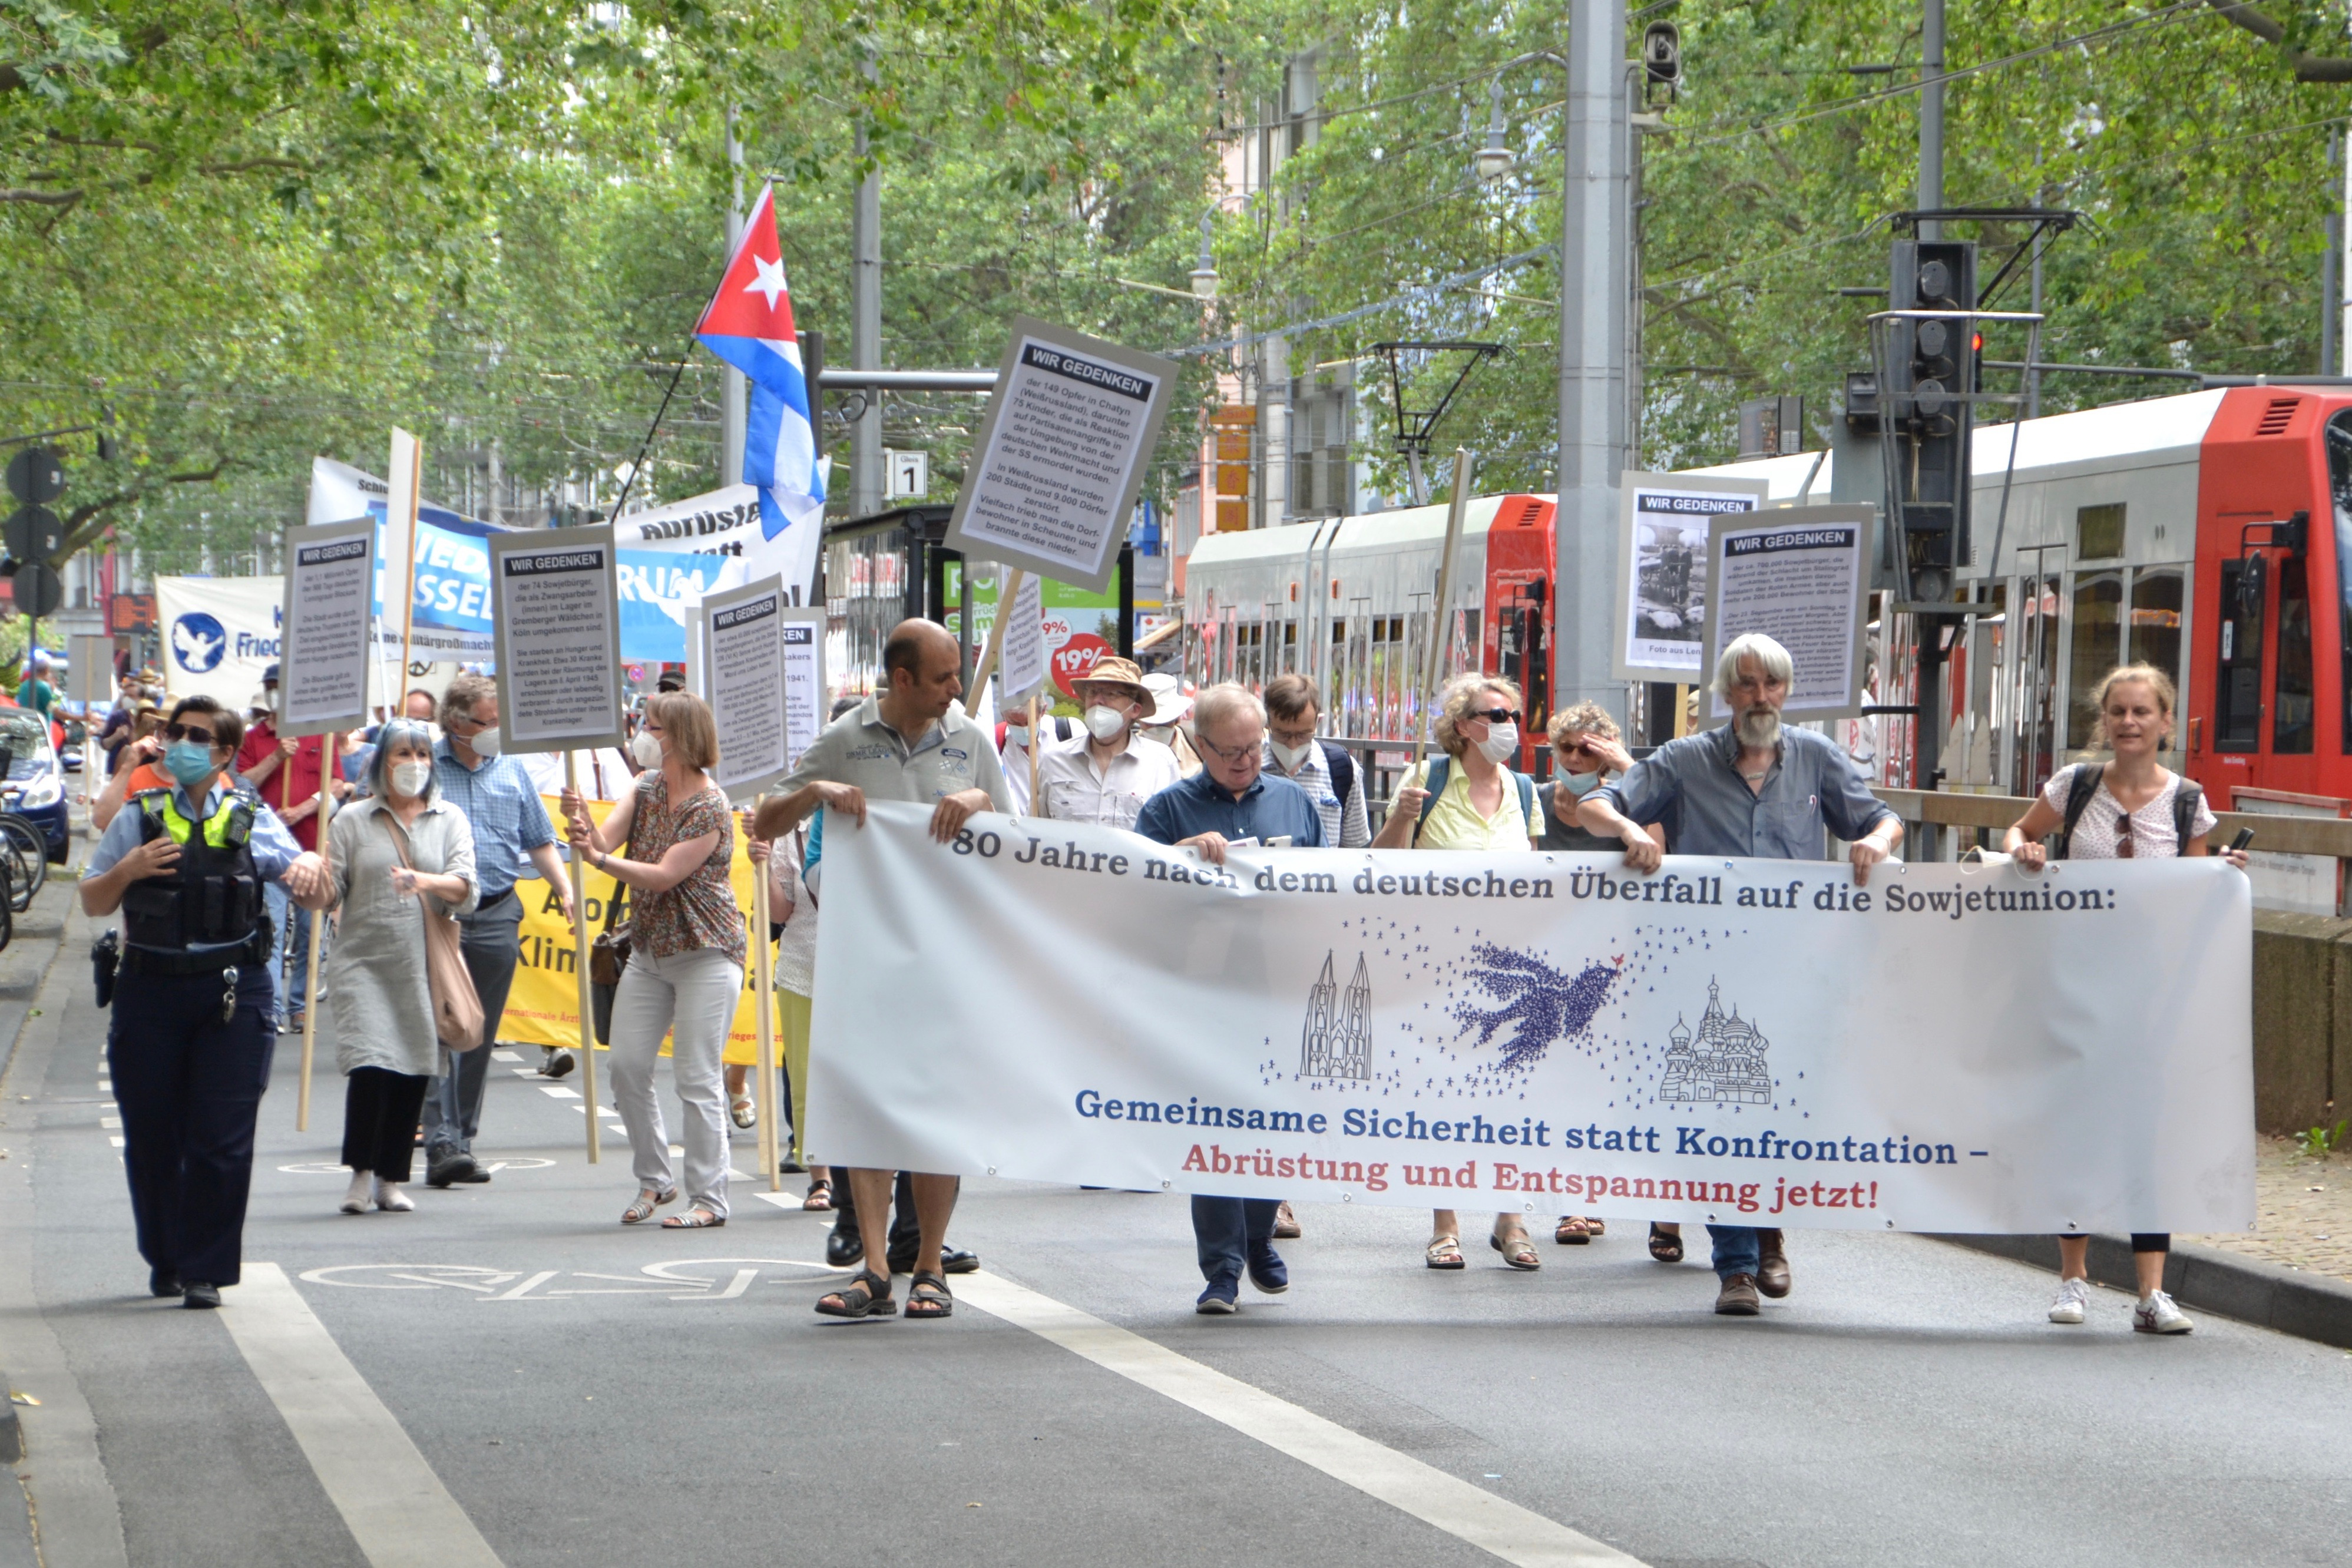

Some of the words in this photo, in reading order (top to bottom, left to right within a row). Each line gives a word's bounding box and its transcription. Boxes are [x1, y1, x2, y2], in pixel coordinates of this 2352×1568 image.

[1033, 348, 1060, 368] WIR
[1062, 359, 1143, 394] GEDENKEN
[1020, 388, 1089, 416] (Weißrussland),
[1091, 410, 1130, 428] darunter
[1026, 378, 1042, 388] der
[1044, 382, 1060, 393] 149
[1061, 387, 1087, 402] Opfer
[1087, 395, 1097, 405] in
[1099, 399, 1131, 416] Chatyn
[1013, 397, 1025, 408] 75
[1026, 401, 1056, 419] Kinder,
[1058, 412, 1073, 423] die
[1074, 418, 1088, 428] als
[1090, 421, 1130, 441] Reaktion
[1013, 412, 1029, 421] auf
[1029, 414, 1111, 447] Partisanenangriffe
[1113, 441, 1122, 451] in
[1001, 432, 1047, 452] deutschen
[1050, 445, 1100, 469] Wehrmacht
[1101, 464, 1120, 475] und
[1013, 424, 1029, 433] der
[1030, 427, 1079, 451] Umgebung
[1080, 445, 1097, 455] von
[1099, 450, 1116, 461] der
[903, 467, 914, 492] 1
[997, 462, 1006, 472] In
[1008, 465, 1069, 491] Weißrussland
[1070, 487, 1104, 502] wurden
[1001, 444, 1017, 454] der
[1018, 448, 1031, 459] SS
[1032, 455, 1074, 473] ermordet
[1075, 468, 1111, 485] wurden.
[985, 471, 1003, 483] 200
[1004, 477, 1033, 492] Städte
[1034, 488, 1053, 498] und
[1053, 492, 1078, 507] 9.000
[1079, 500, 1109, 516] Dörfer
[1023, 497, 1060, 514] zerstört.
[1646, 497, 1670, 509] WIR
[1673, 499, 1745, 512] GEDENKEN
[975, 505, 1020, 525] bewohner
[1020, 519, 1030, 528] in
[1031, 522, 1077, 543] Scheunen
[1078, 539, 1097, 550] und
[980, 494, 1015, 511] Vielfach
[1017, 505, 1038, 518] trieb
[1038, 514, 1059, 525] man
[1060, 520, 1075, 530] die
[1076, 524, 1100, 537] Dorf-
[303, 549, 320, 561] WIR
[322, 542, 363, 559] GEDENKEN
[985, 520, 1020, 538] brannte
[1021, 532, 1046, 546] diese
[1047, 541, 1077, 556] nieder.
[1734, 537, 1761, 551] WIR
[1765, 531, 1845, 548] GEDENKEN
[511, 558, 533, 571] WIR
[535, 553, 597, 569] GEDENKEN
[717, 611, 735, 626] WIR
[736, 599, 773, 621] GEDENKEN
[1042, 621, 1067, 634] 9%
[1686, 647, 1701, 655] Len
[952, 828, 1001, 857] 80
[1014, 837, 1128, 875] Jahre
[1144, 858, 1239, 889] nach
[1254, 865, 1337, 892] dem
[1355, 868, 1553, 898] deutschen
[1570, 866, 1722, 905] Überfall
[1737, 881, 1804, 909] auf
[1814, 882, 1871, 911] die
[1885, 884, 2116, 919] Sowjetunion:
[1075, 1089, 1327, 1134] Gemeinsame
[1343, 1109, 1550, 1147] Sicherheit
[1566, 1123, 1660, 1153] statt
[1676, 1127, 1957, 1165] Konfrontation
[1182, 1144, 1388, 1191] Abrüstung
[1403, 1162, 1477, 1189] und
[1492, 1163, 1760, 1213] Entspannung
[1769, 1177, 1878, 1213] jetzt!
